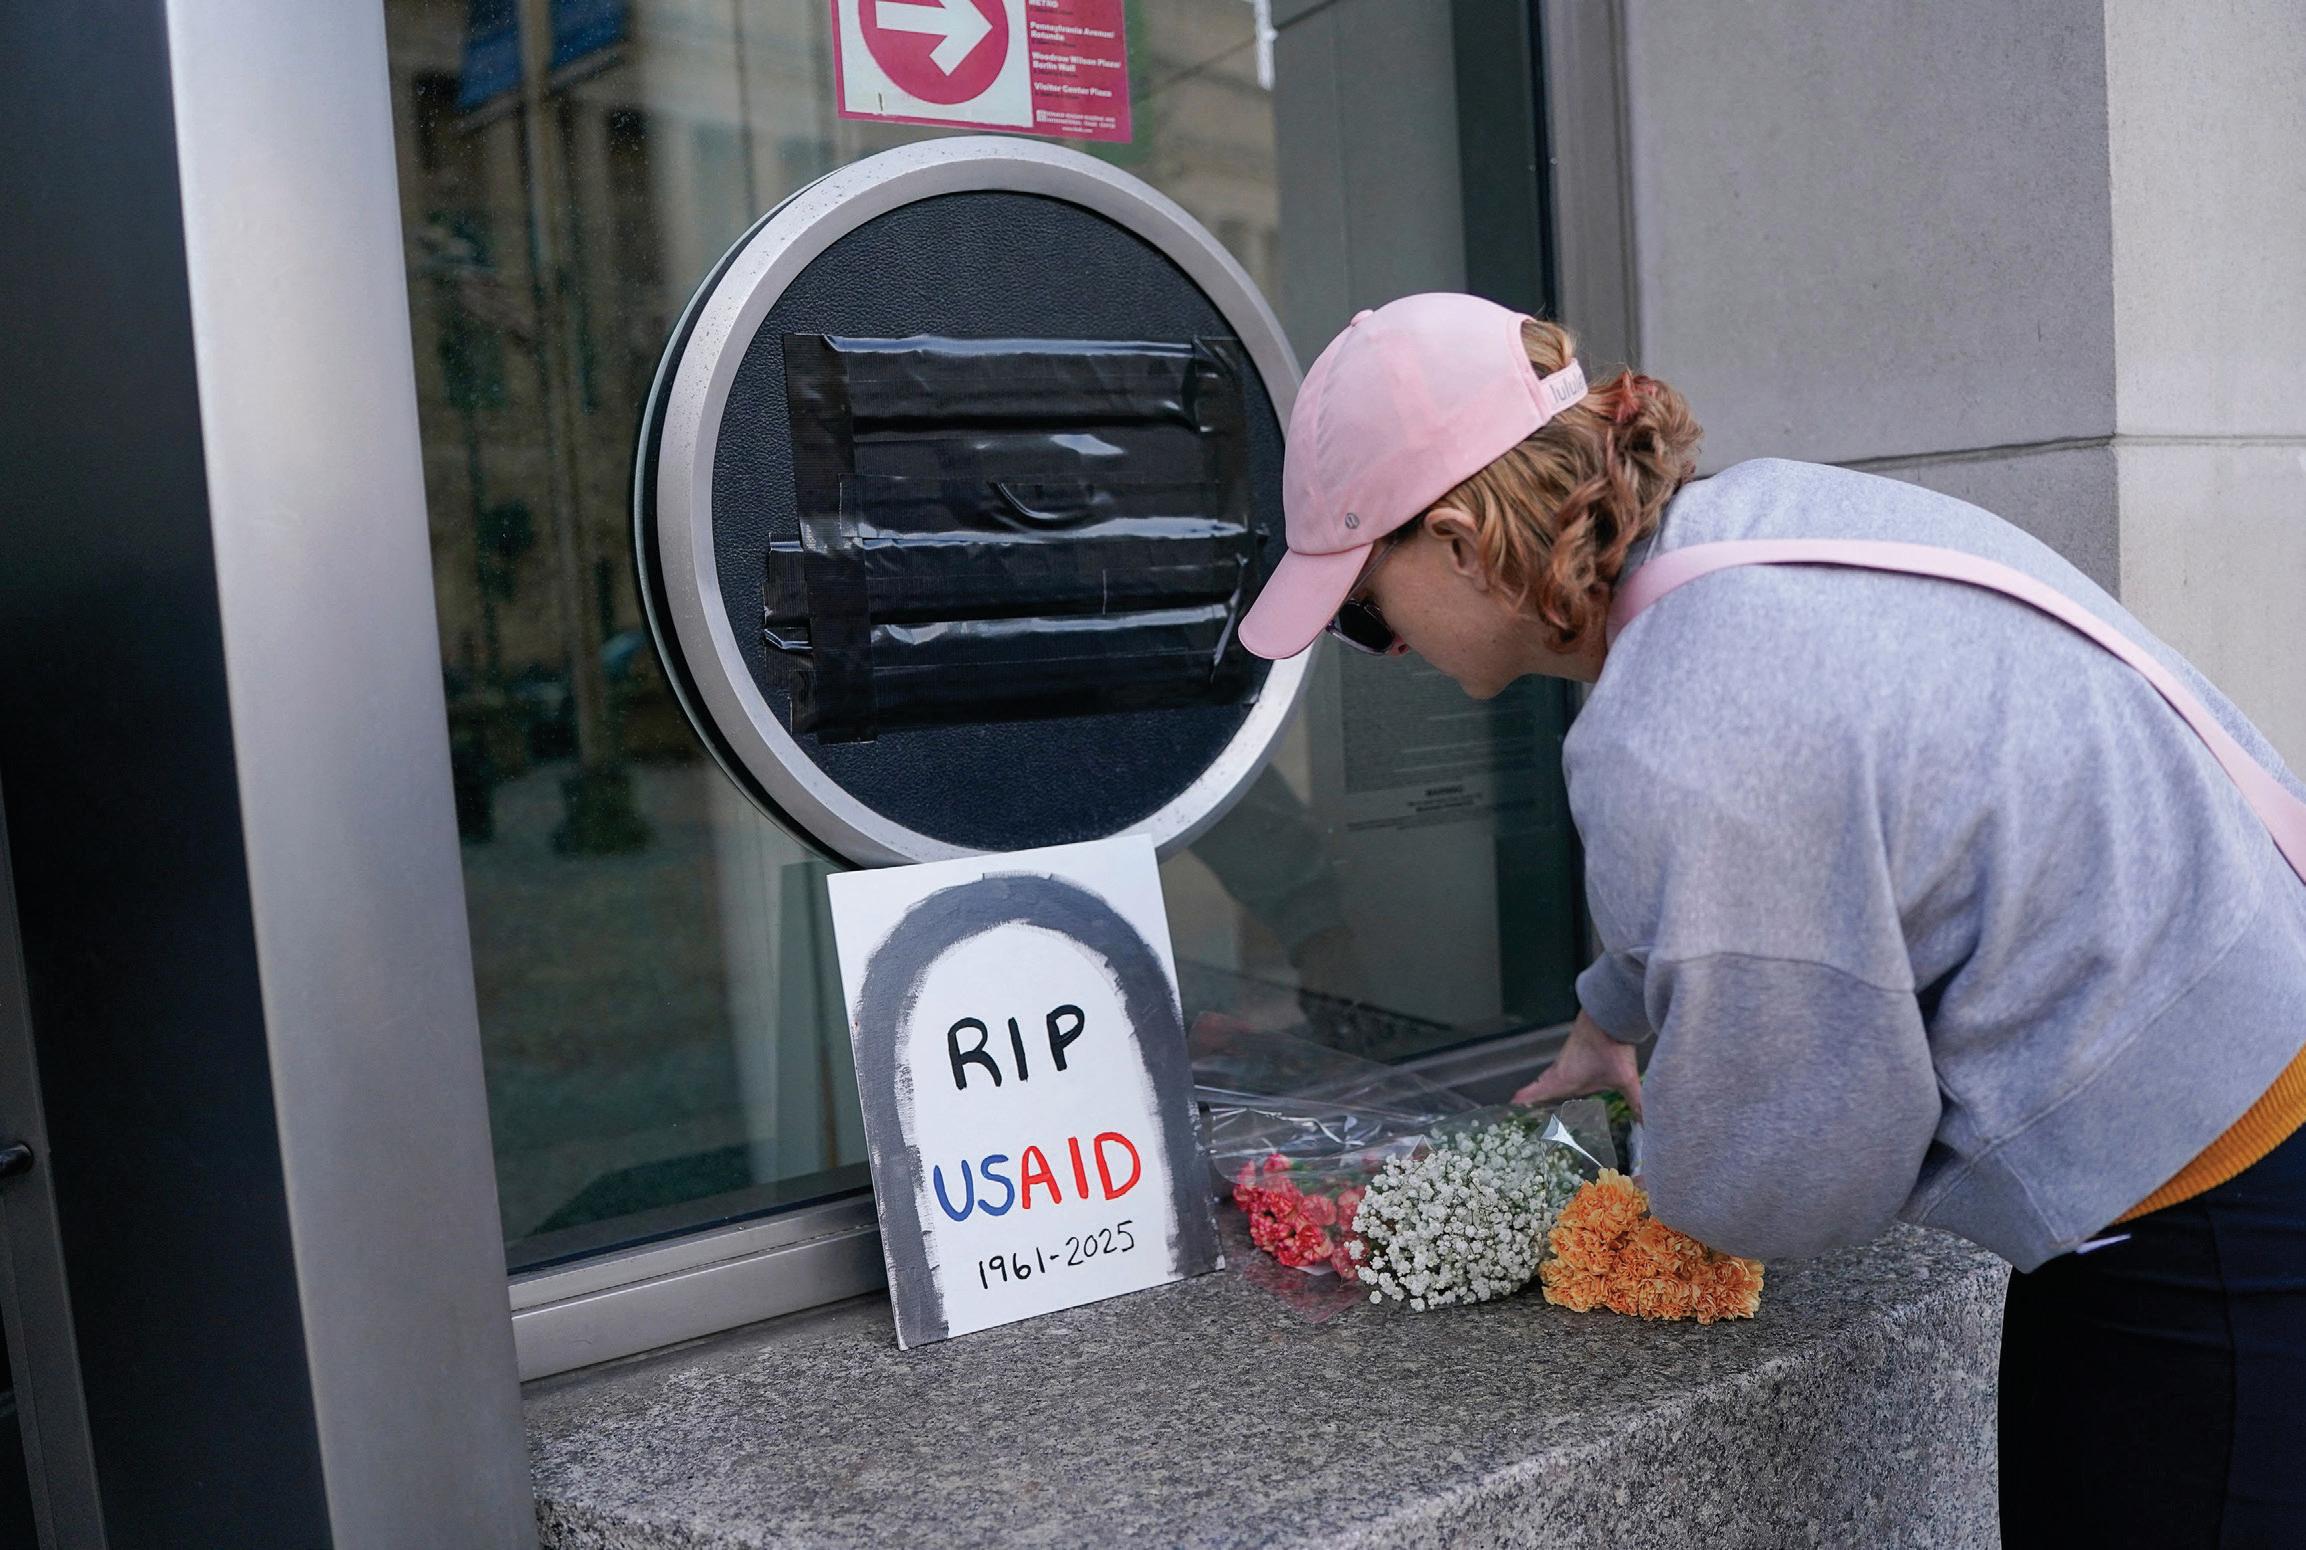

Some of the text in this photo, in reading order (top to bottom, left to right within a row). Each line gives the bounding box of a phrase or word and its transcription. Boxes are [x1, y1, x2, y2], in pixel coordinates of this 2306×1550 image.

[1030, 22, 1083, 35] Pennsylvania
[1031, 30, 1065, 40] Rotunda
[1032, 52, 1069, 62] Woodrow
[1070, 56, 1097, 65] Wilson
[1033, 61, 1076, 72] Berlin Wall
[1034, 83, 1061, 92] Visitor
[1062, 85, 1089, 94] Center
[1090, 88, 1112, 97] Plaza
[947, 1004, 1086, 1090] RIP
[933, 1131, 1142, 1223] USAID
[978, 1220, 1136, 1290] 1961-2025
